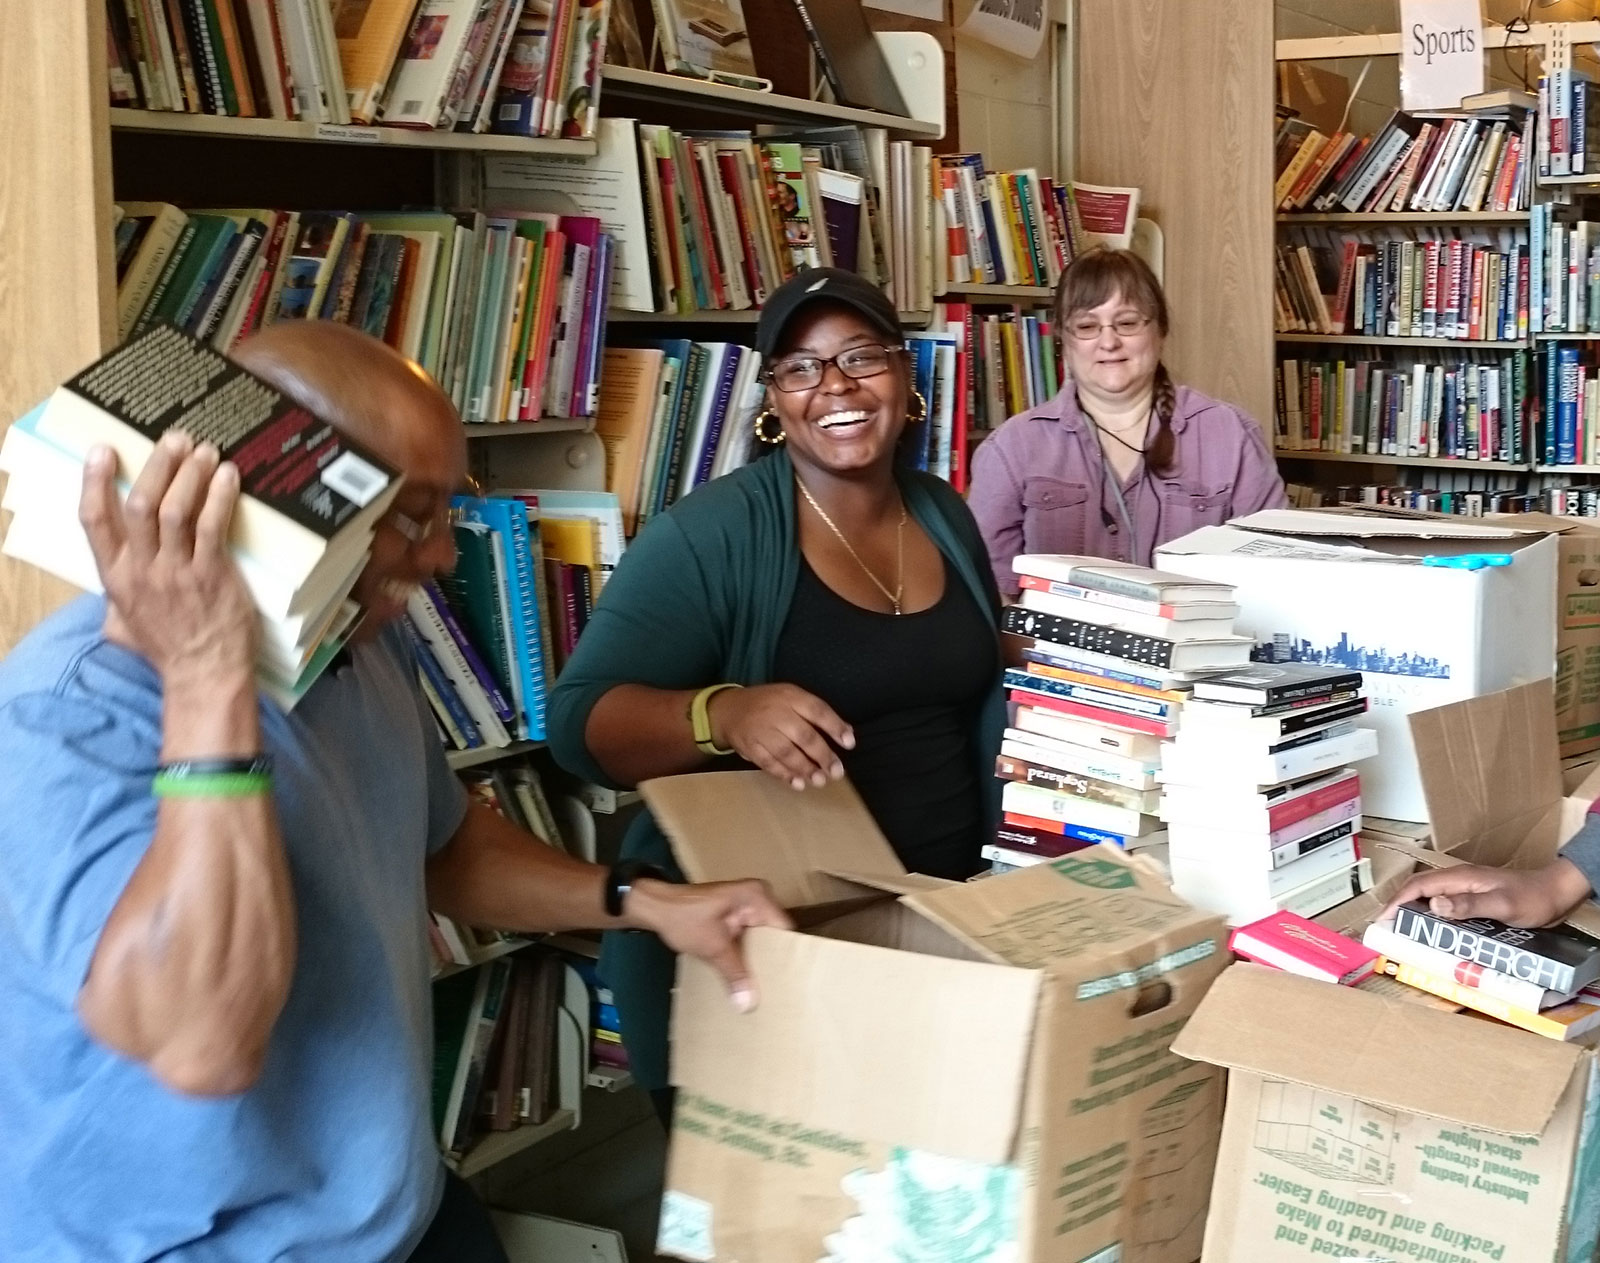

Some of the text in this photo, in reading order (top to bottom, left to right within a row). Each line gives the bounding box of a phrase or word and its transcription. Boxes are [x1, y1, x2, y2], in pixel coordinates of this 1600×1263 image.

[1412, 22, 1476, 65] Sports
[1427, 246, 1438, 305] AMERICAN ICON
[1450, 245, 1461, 305] AMERICAN ICON
[725, 355, 737, 379] OUR
[670, 390, 691, 473] DECORATOR'S
[1150, 642, 1159, 664] WALTER
[1027, 768, 1088, 794] Sepharad
[1394, 909, 1562, 990] LINDBERGH
[1437, 1128, 1523, 1163] stack higher
[1419, 1160, 1530, 1205] Industry leading
[1482, 1160, 1541, 1187] sidewall
[1276, 1201, 1323, 1232] Make
[1316, 1190, 1388, 1227] Loading
[1391, 1214, 1426, 1237] and
[1273, 1224, 1307, 1248] and
[1326, 1219, 1344, 1239] to
[1430, 1221, 1506, 1262] Packing
